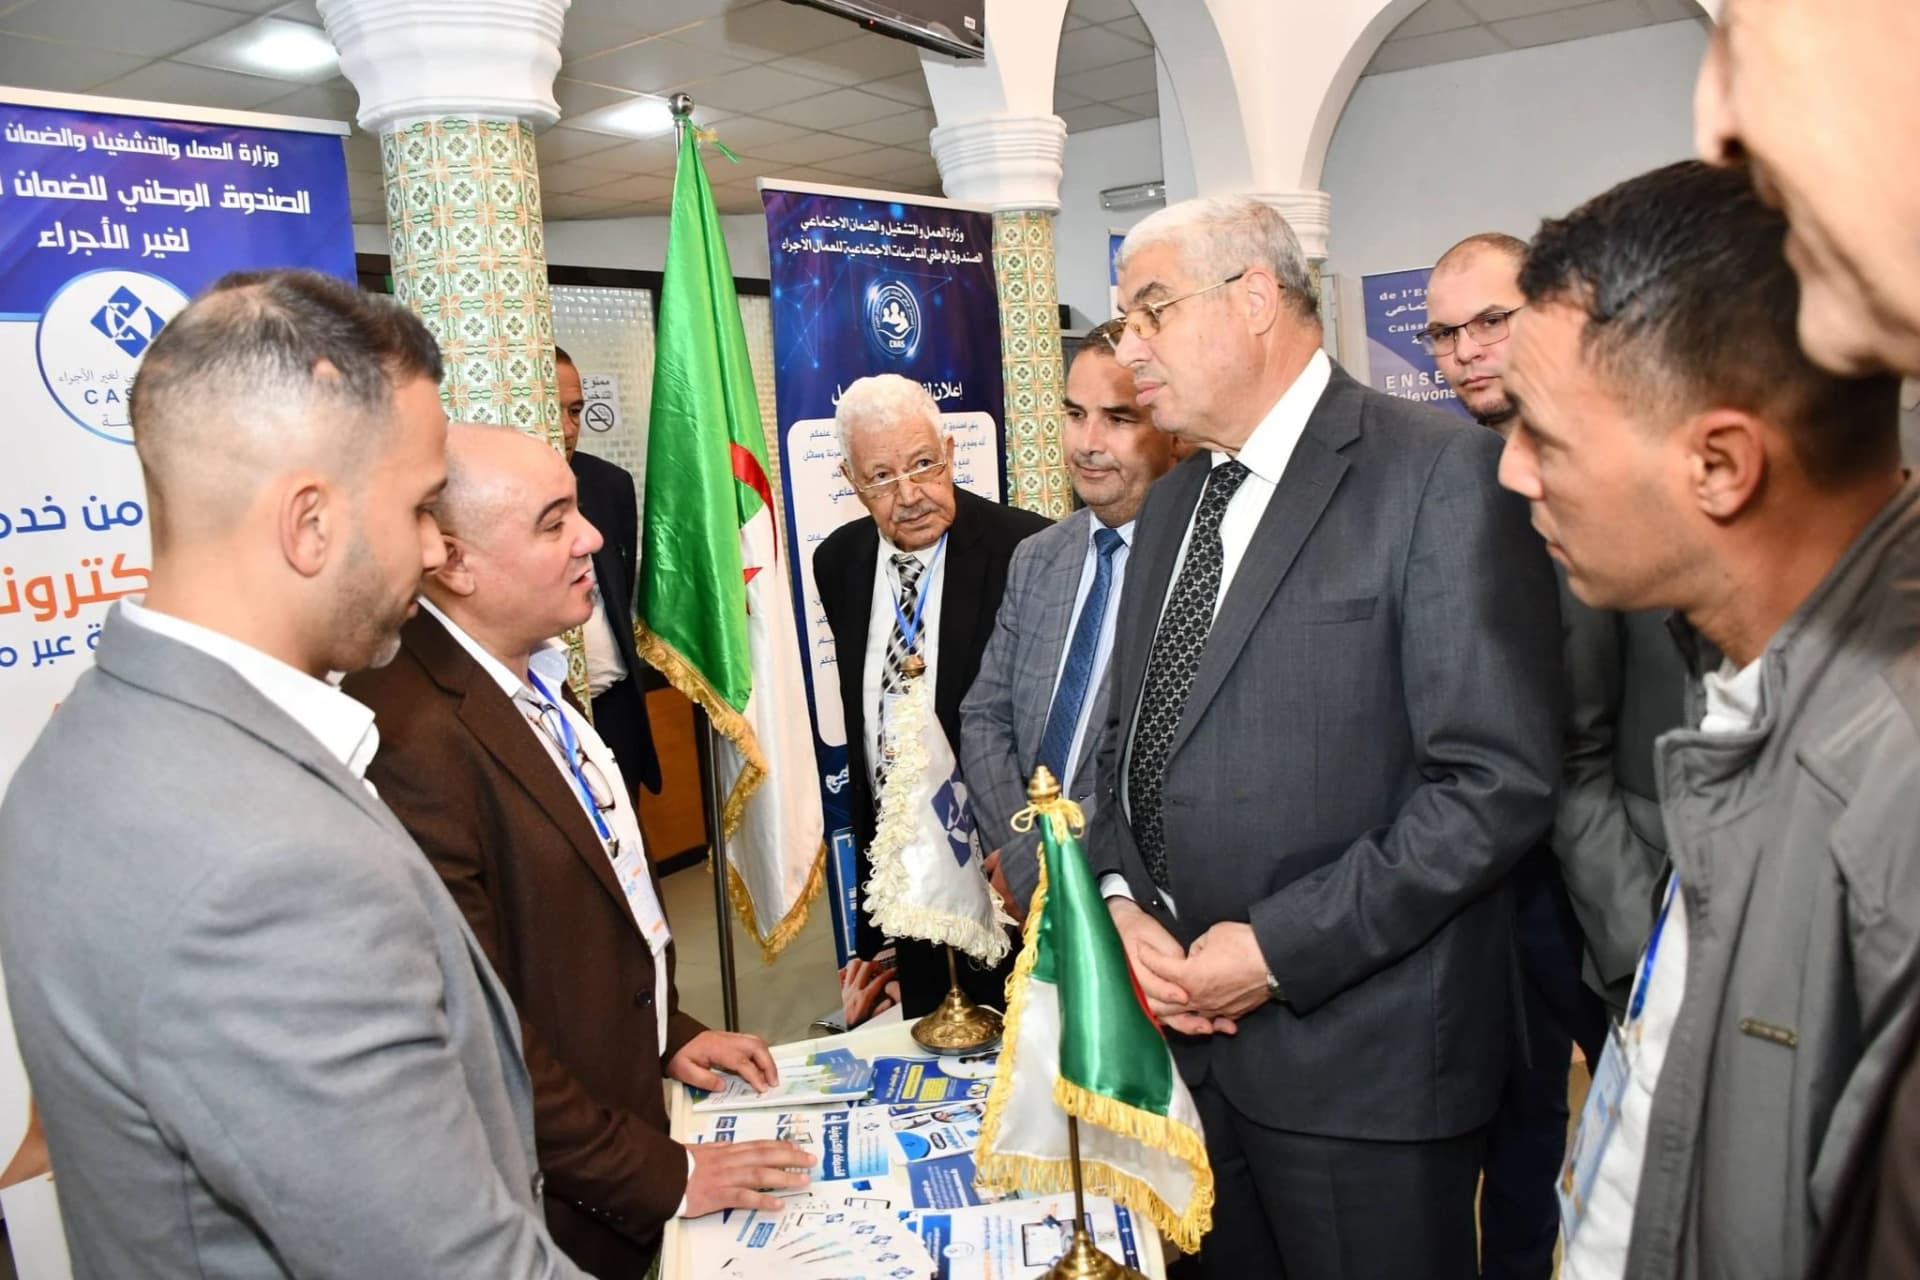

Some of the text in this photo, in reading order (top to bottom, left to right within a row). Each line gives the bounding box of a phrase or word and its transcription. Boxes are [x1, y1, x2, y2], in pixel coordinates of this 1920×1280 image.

[5, 121, 279, 167] وزارة العمل والتشغيل والضمان
[14, 169, 109, 201] للضمان
[117, 179, 210, 213] الوطني
[219, 185, 311, 215] الصندوق
[37, 215, 191, 259] لغير الأجراء
[923, 224, 946, 240] العمل
[946, 227, 965, 243] وزارة
[812, 239, 844, 254] للعمال
[926, 250, 950, 265] الوطني
[950, 251, 984, 265] الصندوق
[1379, 291, 1397, 302] de
[1385, 369, 1446, 390] ENSE
[84, 387, 133, 405] CAS
[1387, 388, 1457, 402] levons
[82, 494, 144, 532] من
[32, 634, 76, 668] عبر
